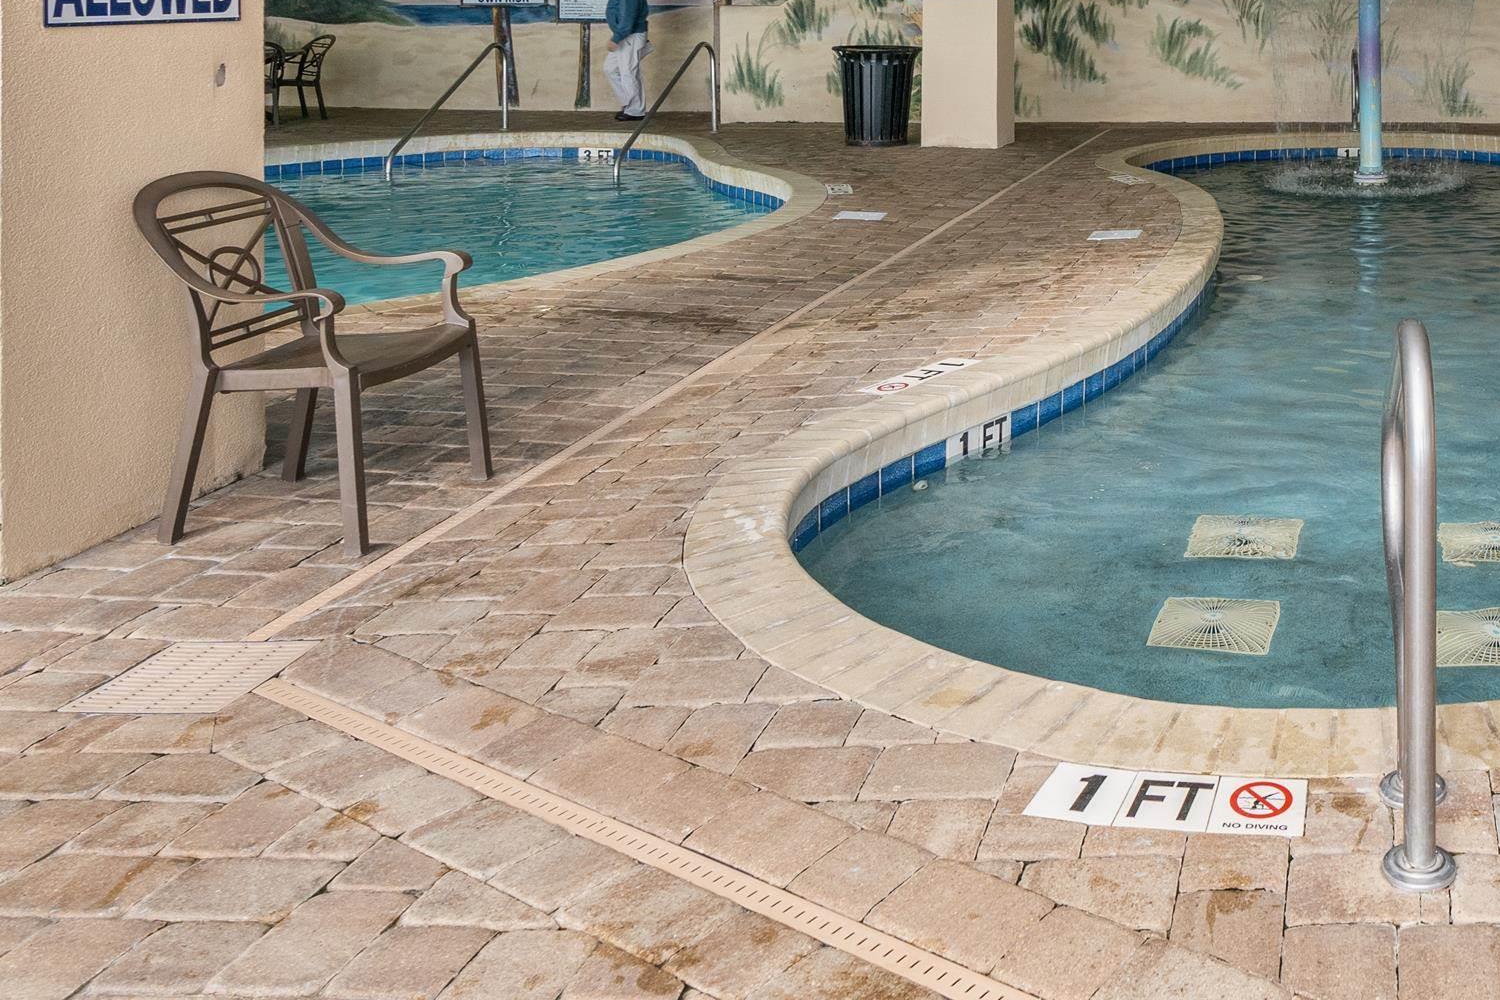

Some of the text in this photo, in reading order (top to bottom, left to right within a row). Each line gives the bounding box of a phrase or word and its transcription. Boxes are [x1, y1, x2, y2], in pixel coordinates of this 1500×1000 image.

[583, 149, 611, 161] 3 FT
[1344, 149, 1350, 157] 1
[903, 369, 945, 381] FT
[959, 416, 1008, 456] 1 FT
[1069, 773, 1215, 821] 1 FT
[1245, 823, 1288, 831] DIVING
